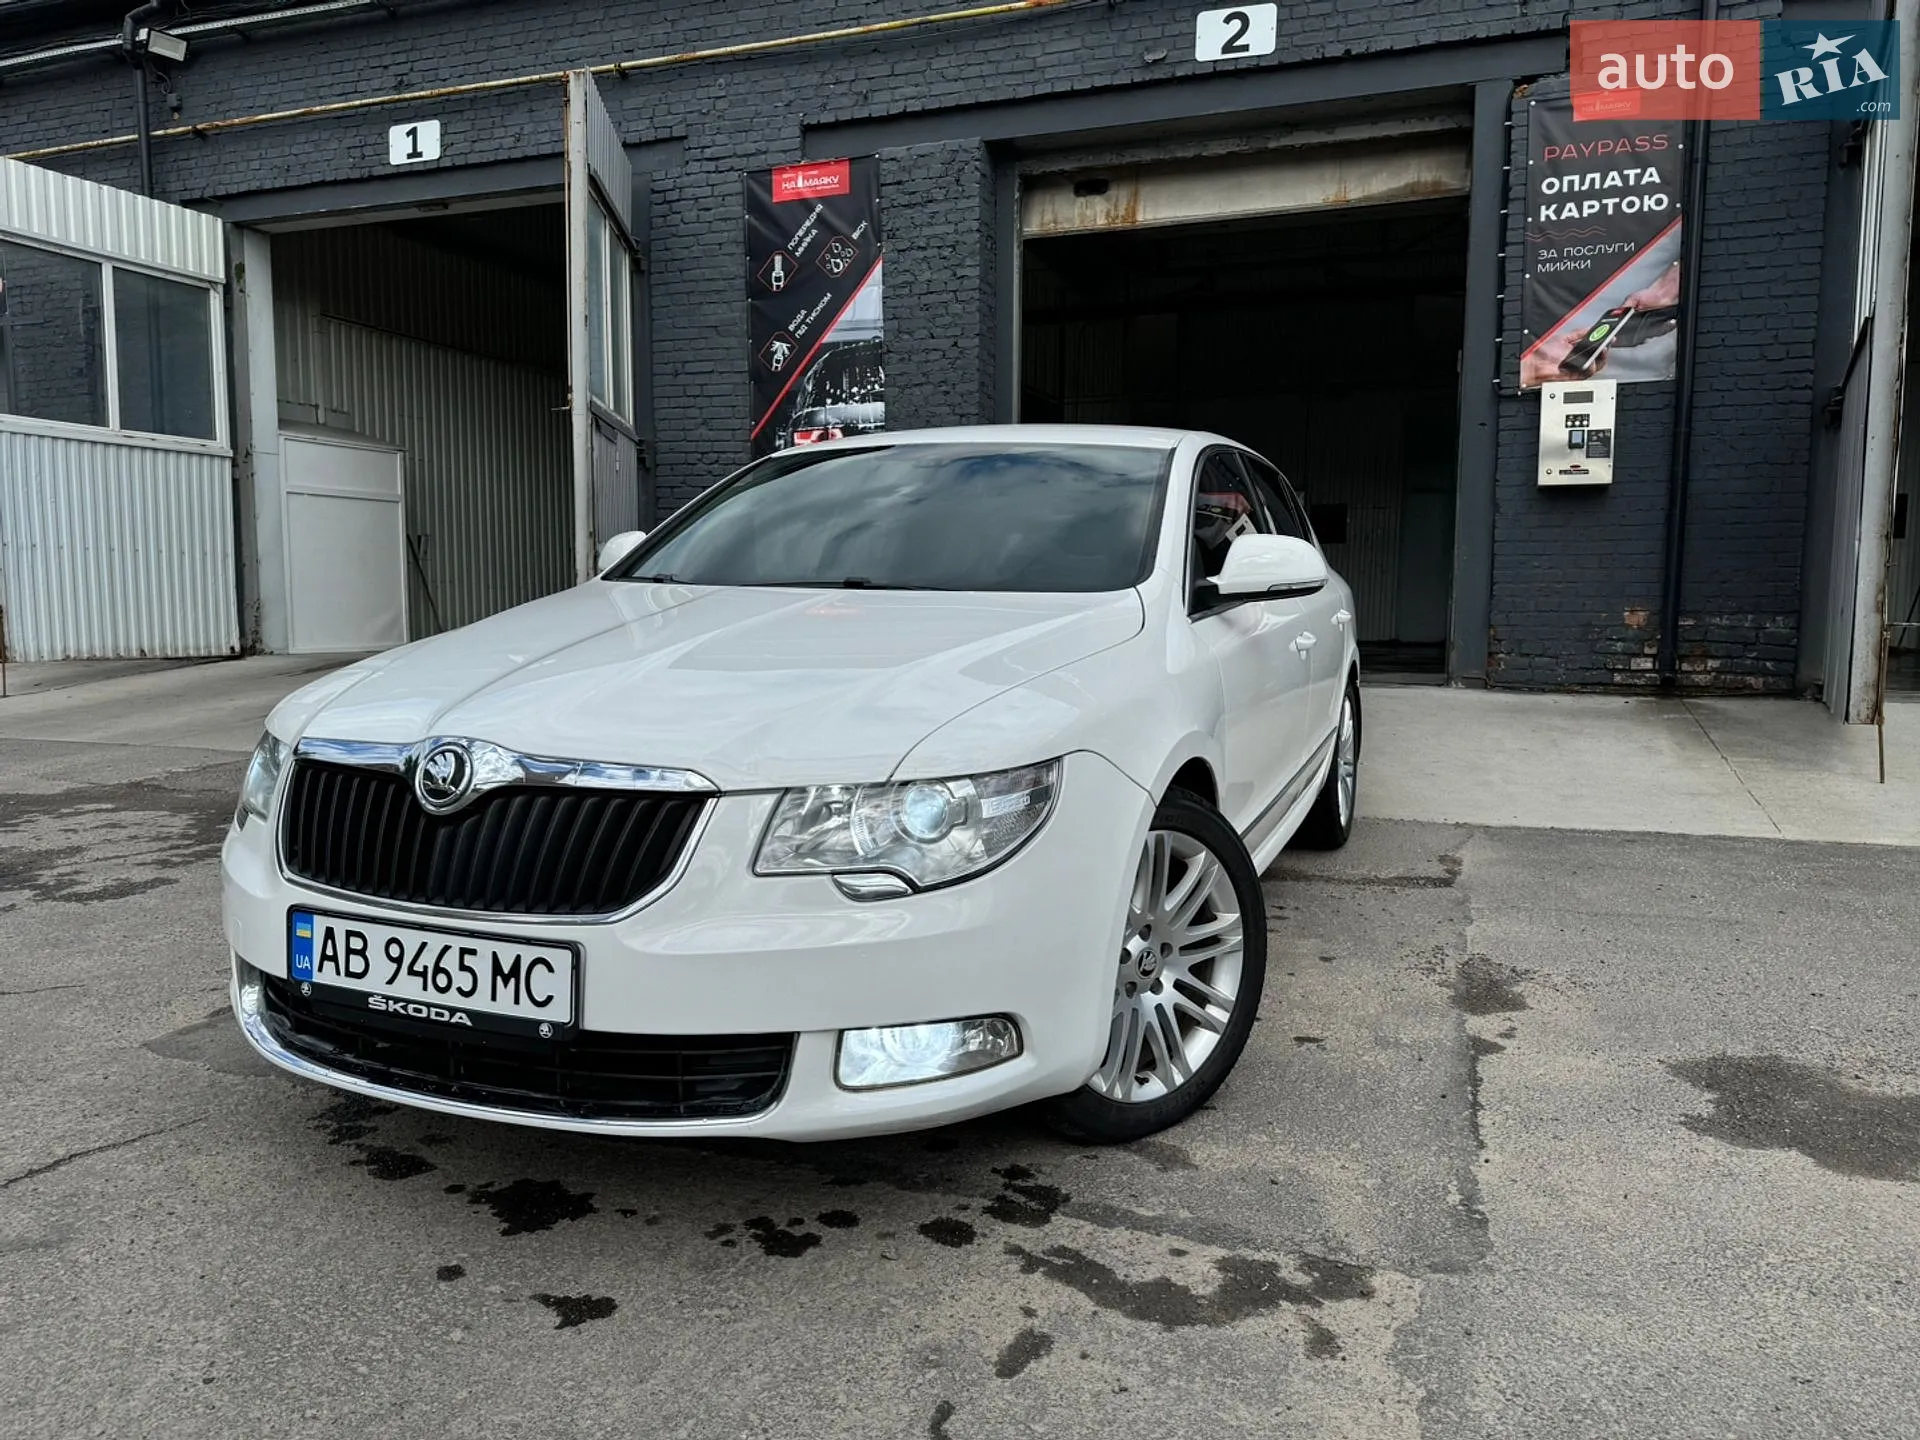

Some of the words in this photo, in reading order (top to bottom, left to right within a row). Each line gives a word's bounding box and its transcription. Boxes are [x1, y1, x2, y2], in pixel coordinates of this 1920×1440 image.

[1222, 11, 1250, 54] 2
[405, 126, 423, 160] 1
[1544, 134, 1669, 162] PAYPASS
[1541, 166, 1661, 195] ОПЛАТА
[1539, 193, 1669, 222] КАРТОЮ
[1537, 249, 1558, 260] ЗА
[1563, 242, 1635, 258] ПОСЛУГИ
[1537, 259, 1591, 273] МИЙКИ
[295, 954, 311, 970] UA
[317, 926, 371, 980] AB
[384, 936, 478, 998] 9465
[490, 950, 556, 1008] MC
[367, 993, 473, 1028] ŠKODA
